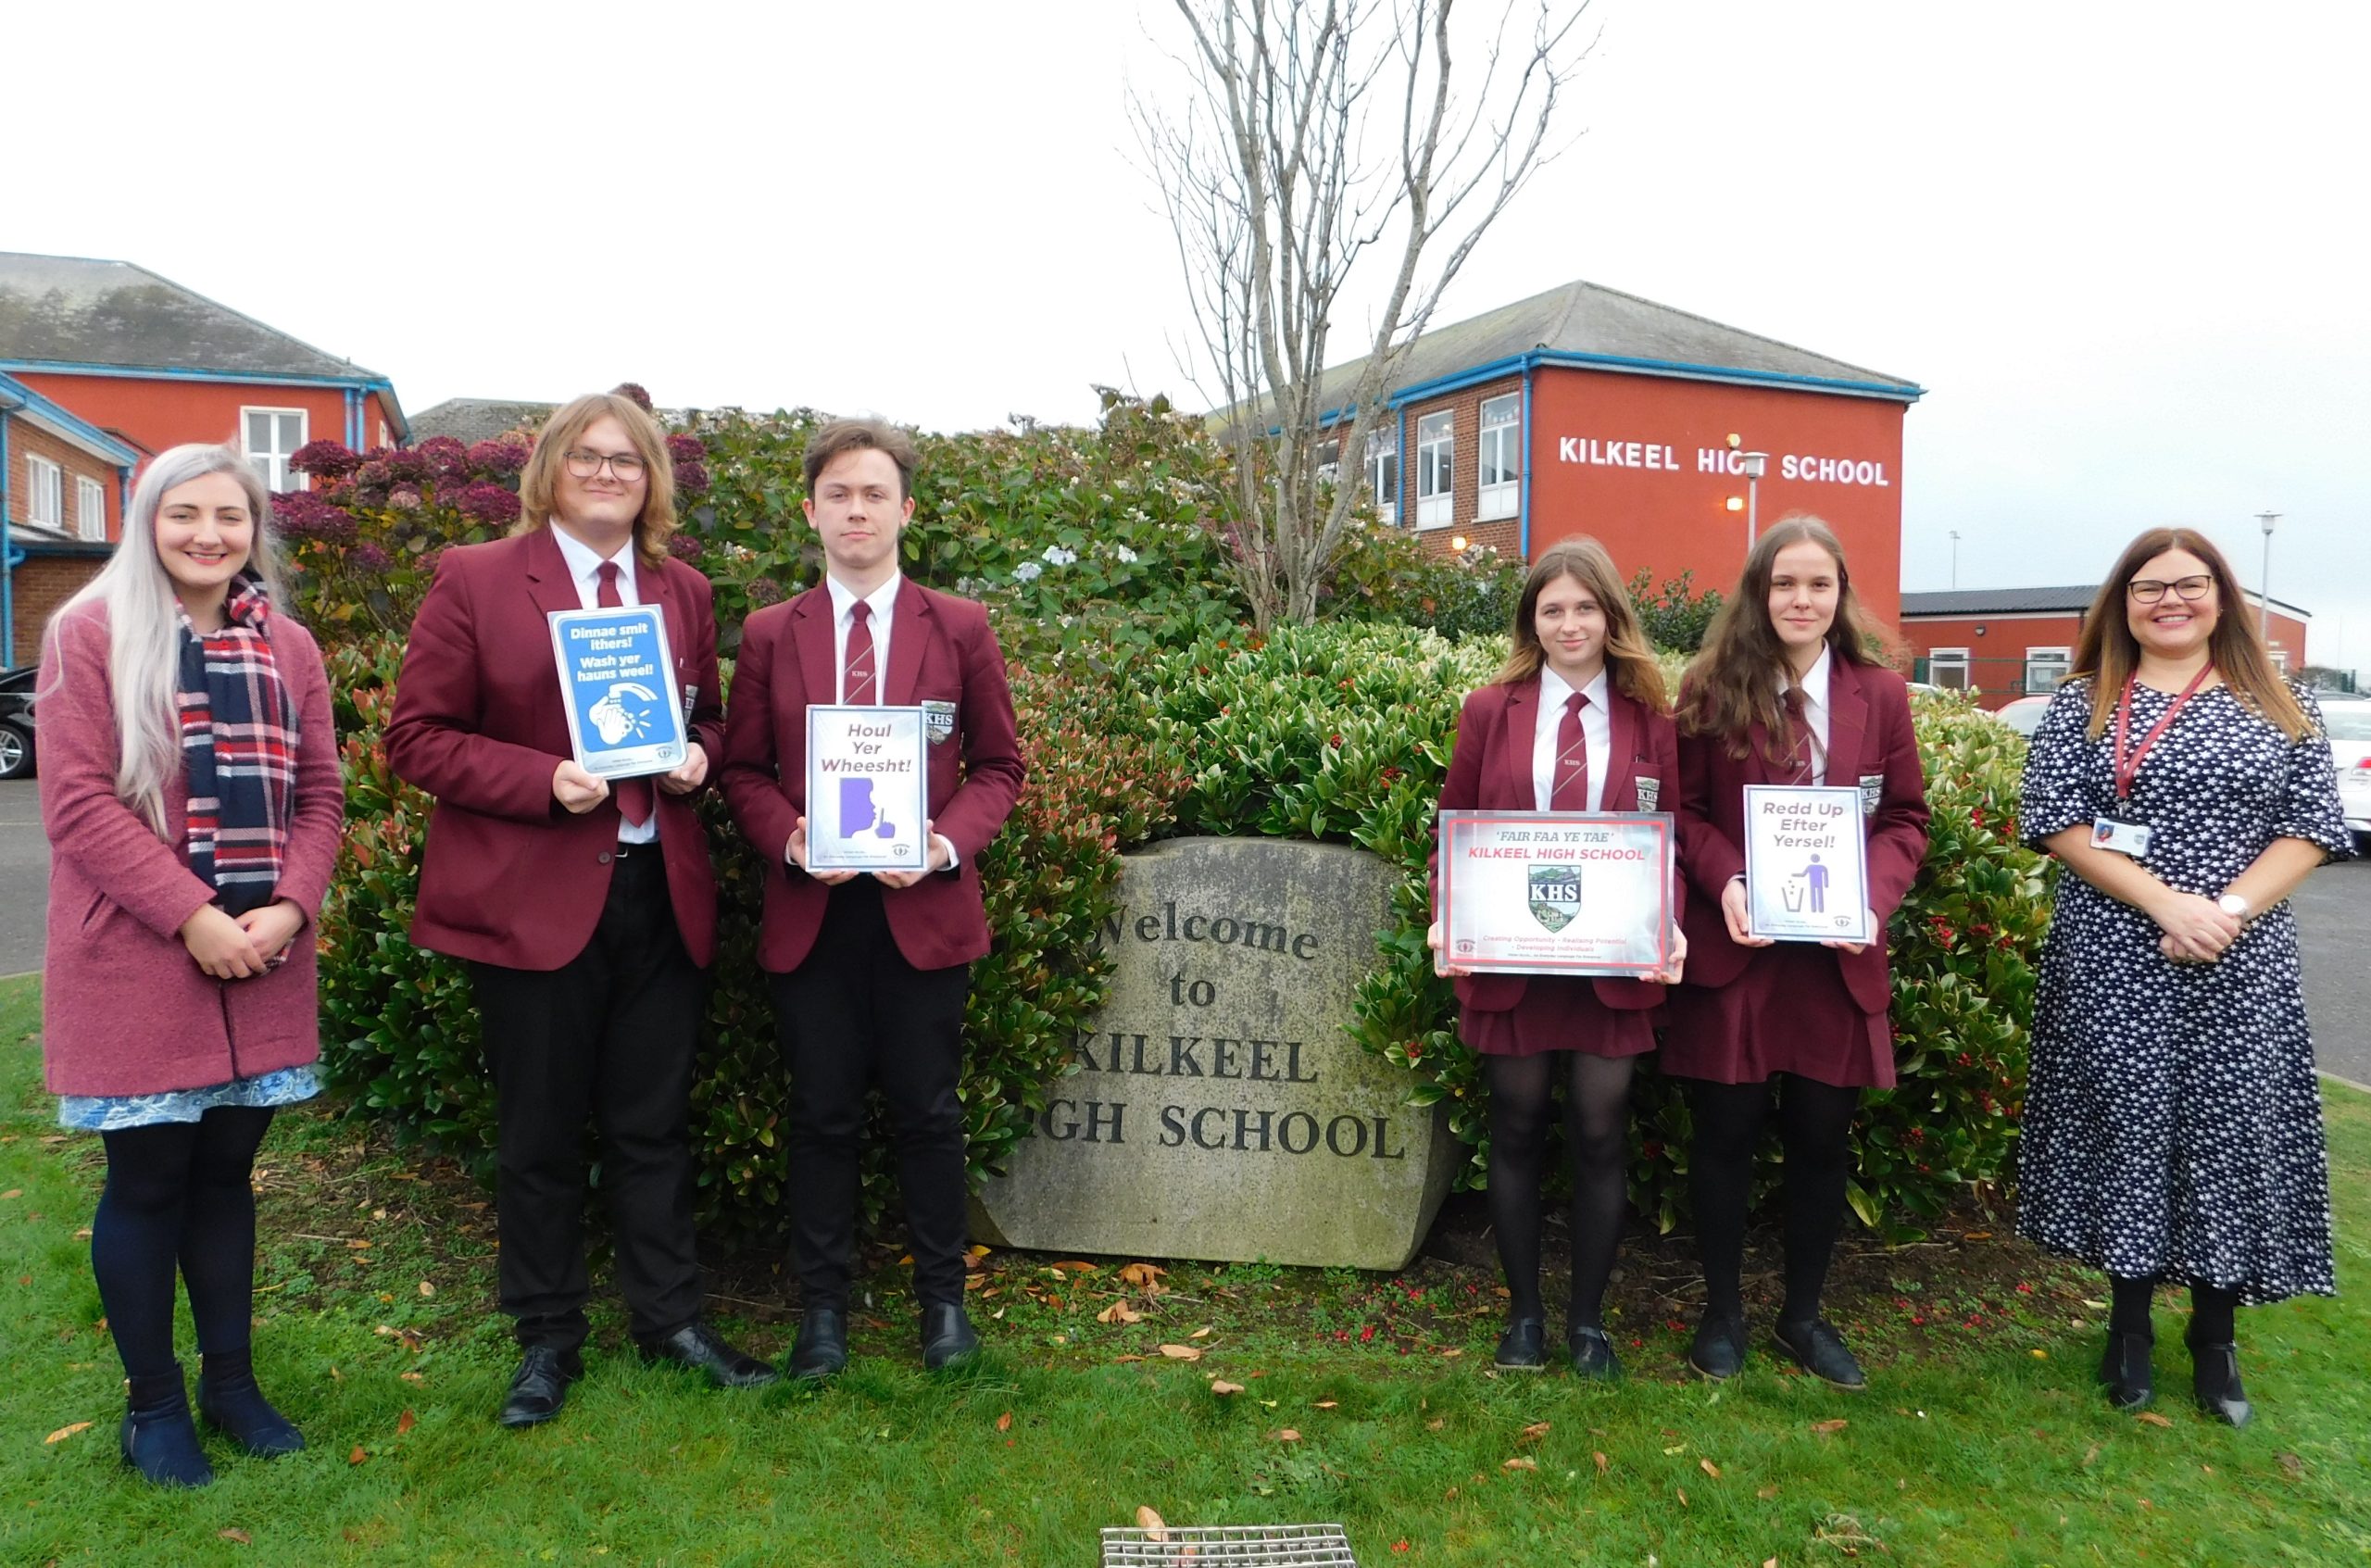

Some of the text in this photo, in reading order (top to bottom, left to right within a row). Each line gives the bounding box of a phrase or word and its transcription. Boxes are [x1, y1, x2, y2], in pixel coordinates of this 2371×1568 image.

[1560, 437, 1680, 470] KILKEEL
[1781, 455, 1888, 486] SCHOOL
[570, 622, 648, 640] Dinnae smit
[590, 637, 633, 651] ithers!
[580, 654, 641, 669] Wash yer
[577, 664, 654, 683] hauns weel!
[925, 712, 953, 726] KHS
[847, 723, 892, 737] Houl
[852, 741, 883, 755] Yer
[822, 759, 911, 772] Wheesht!
[1763, 802, 1844, 818] Redd Up
[1780, 819, 1828, 832] Efter
[1533, 832, 1559, 842] FAA
[1563, 832, 1581, 842] YE
[1774, 834, 1836, 848] Yersel!
[1468, 847, 1645, 860] KILKEEL HIGH SCHOOL
[1529, 883, 1578, 902] KHS
[1089, 902, 1319, 960] Welcome
[1171, 970, 1216, 1007] to
[1069, 1032, 1318, 1084] KILKEEL
[1159, 1105, 1405, 1160] SCHOOL
